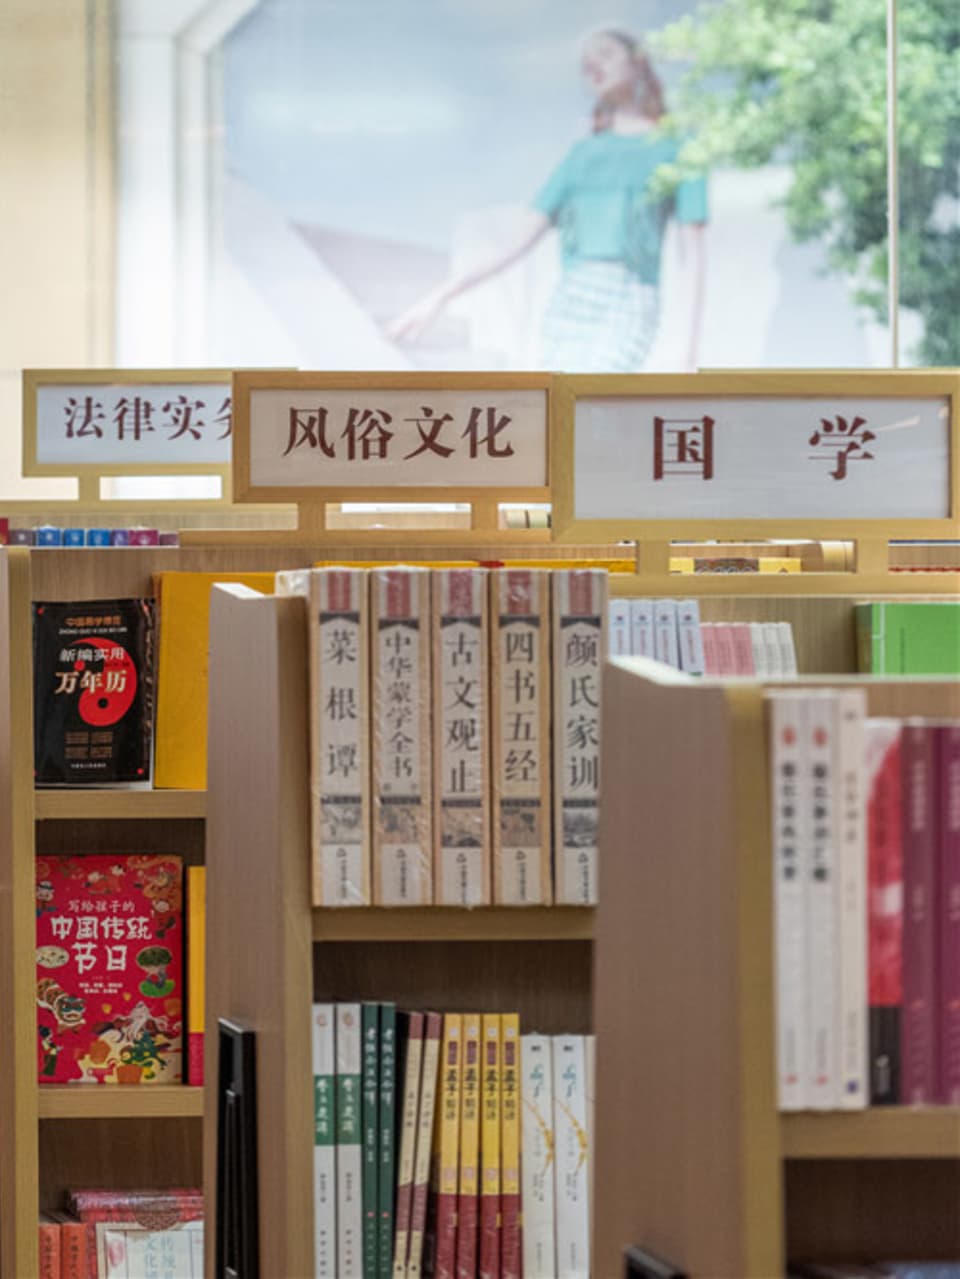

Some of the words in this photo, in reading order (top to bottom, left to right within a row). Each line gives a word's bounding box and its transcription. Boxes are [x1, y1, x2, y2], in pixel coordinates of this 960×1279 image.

[281, 403, 516, 460] 风俗文化
[651, 415, 877, 482] 国学
[53, 669, 128, 695] 万年历
[58, 647, 125, 663] 新编实用
[324, 628, 358, 779] 菜根谭
[382, 631, 415, 779] 中华蒙学全书
[445, 631, 479, 794] 古文观止
[503, 631, 538, 784] 四书五经
[565, 632, 600, 792] 颜氏家训
[50, 915, 153, 940] 中国传统
[68, 899, 136, 913] 写给孩子的
[72, 942, 128, 974] 节日
